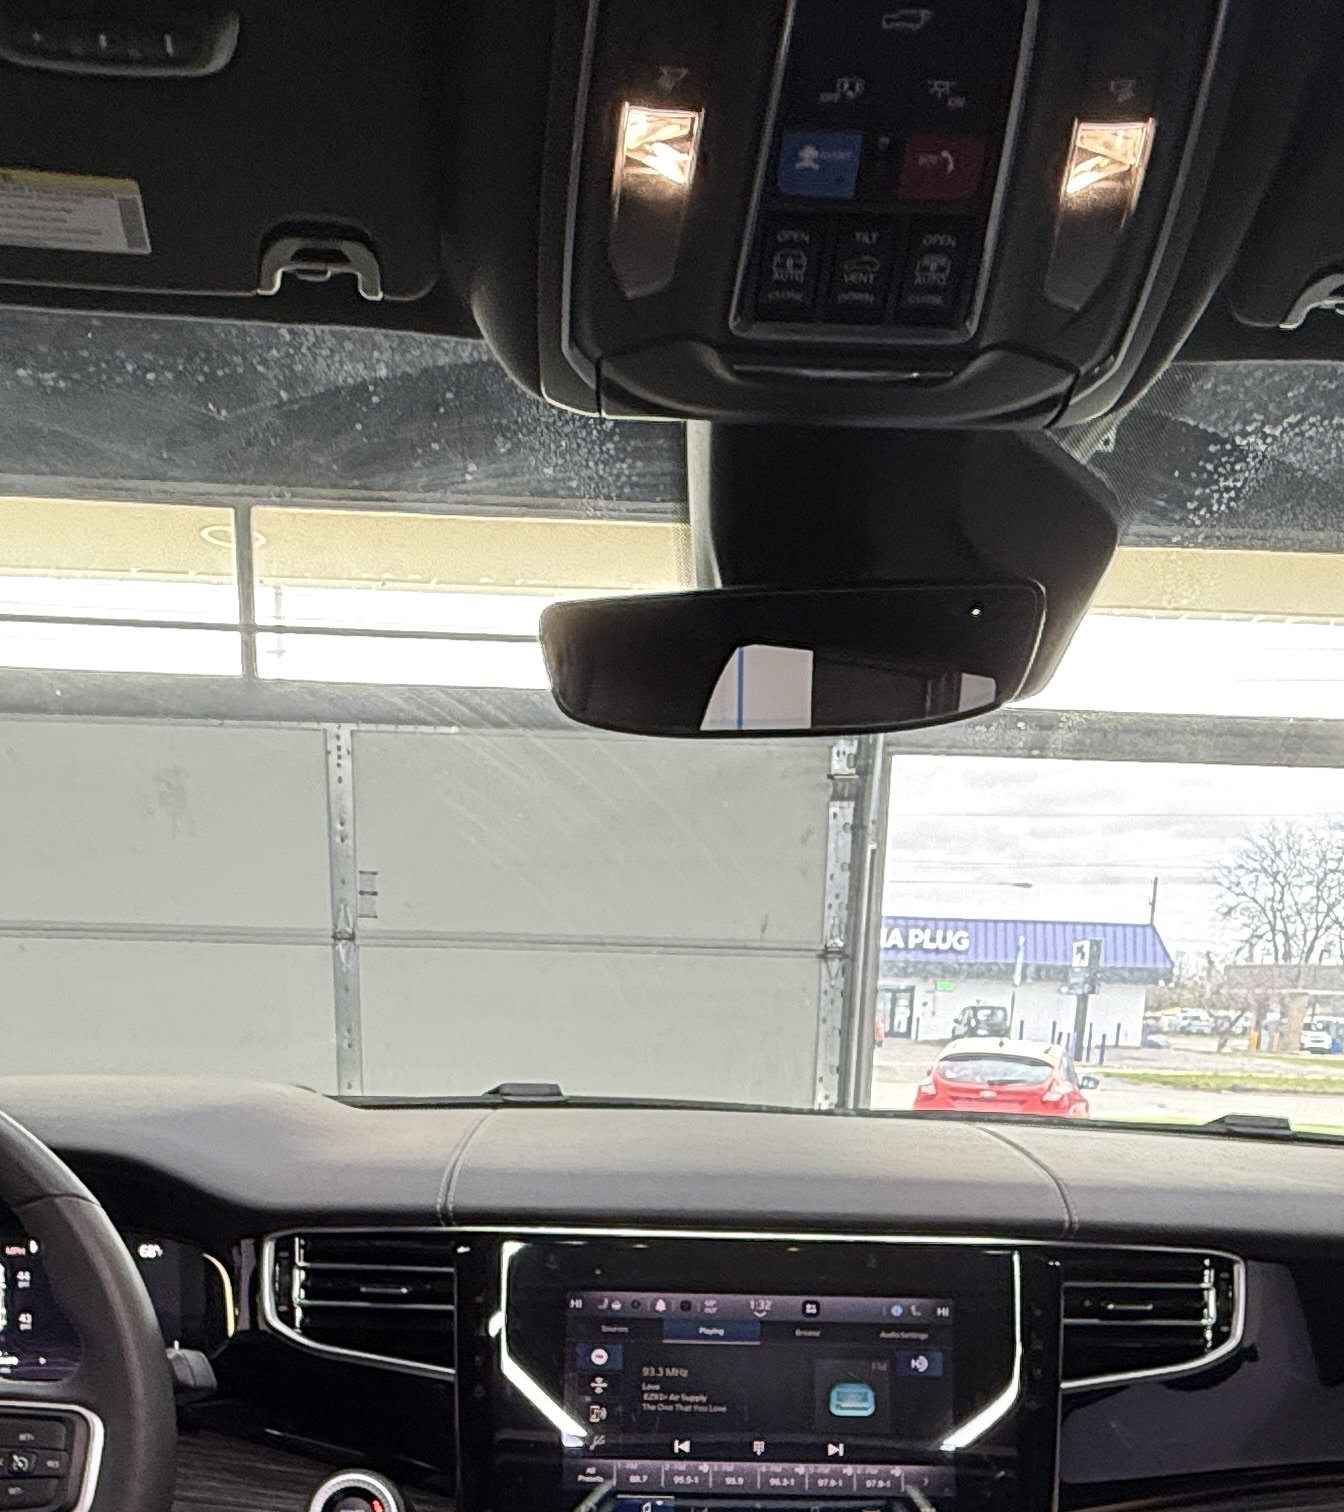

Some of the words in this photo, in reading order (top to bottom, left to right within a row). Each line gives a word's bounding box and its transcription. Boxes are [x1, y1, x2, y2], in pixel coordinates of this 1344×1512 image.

[908, 928, 970, 951] PLUG
[569, 1300, 583, 1309] HI
[750, 1299, 772, 1310] 1:32
[937, 1307, 949, 1317] HI
[641, 1367, 664, 1377] 93.3
[665, 1368, 689, 1378] MHz
[642, 1403, 657, 1411] The
